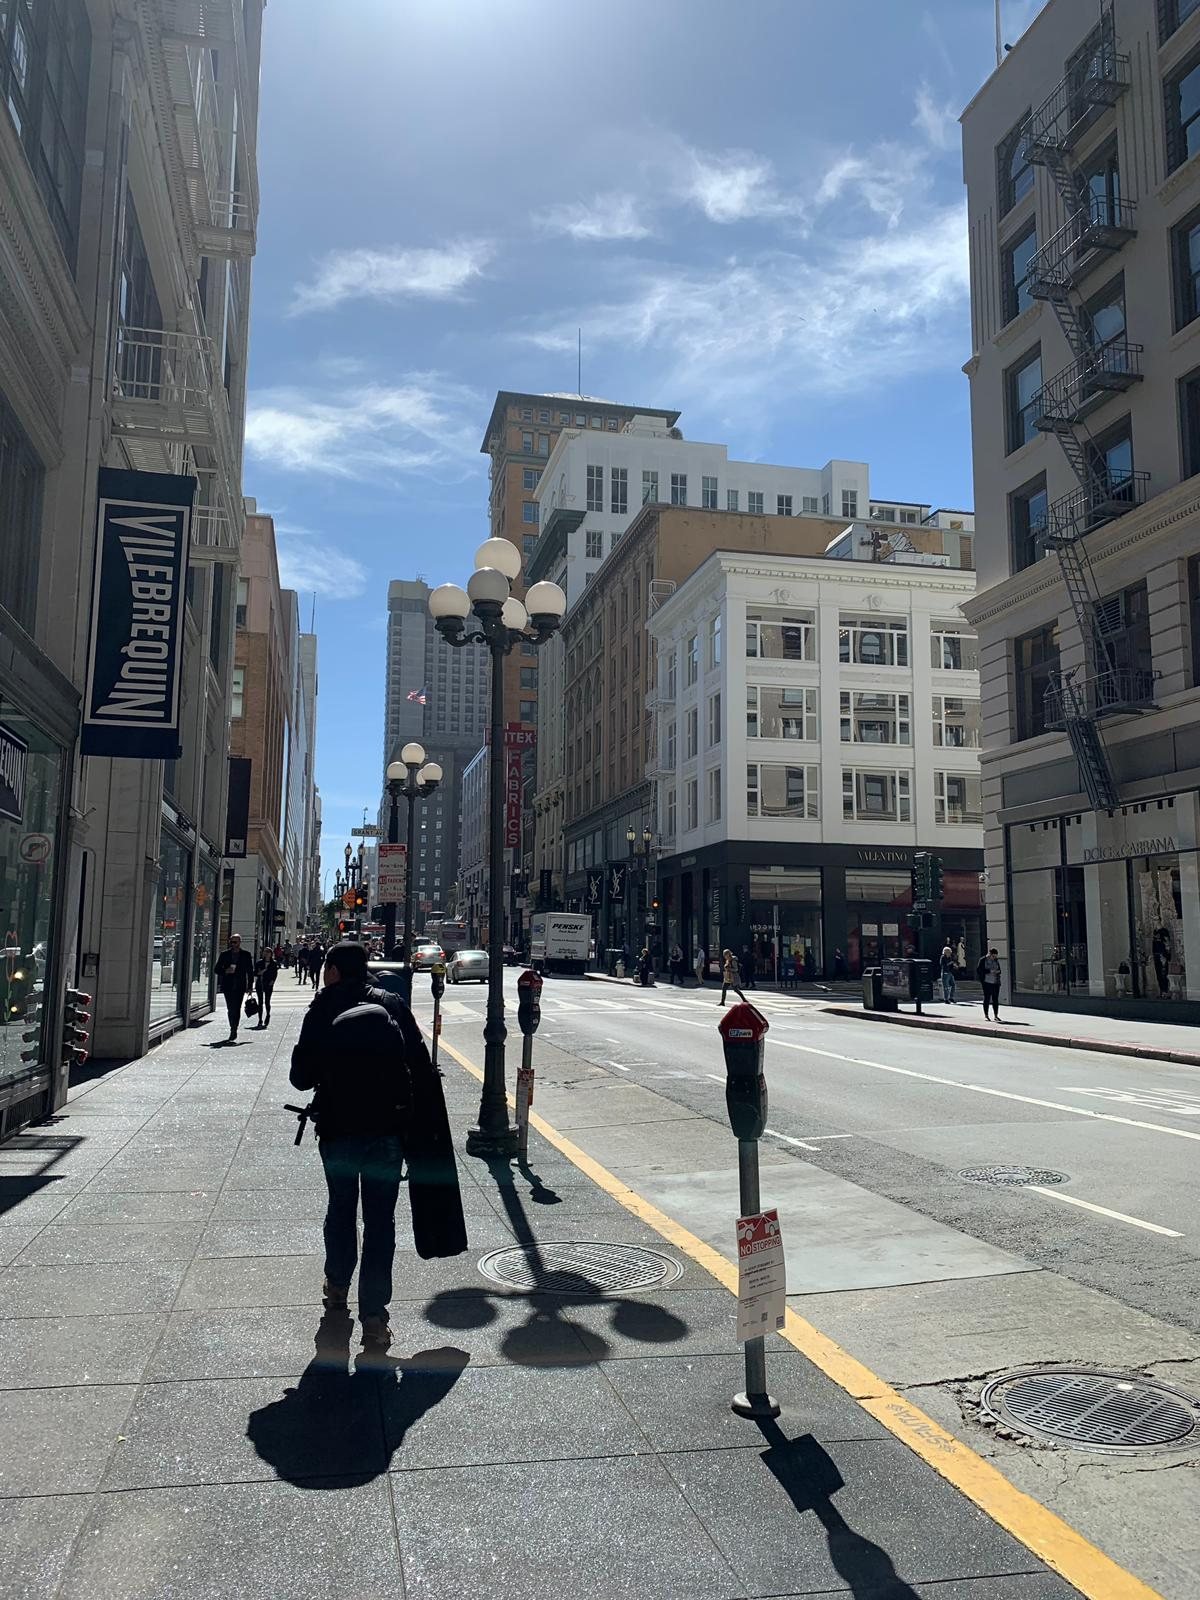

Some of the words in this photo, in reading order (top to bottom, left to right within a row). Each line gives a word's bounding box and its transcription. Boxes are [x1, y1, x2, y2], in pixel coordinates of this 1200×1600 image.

[96, 515, 177, 718] VILEBREQUIN
[0, 737, 25, 812] EQUIN
[508, 749, 519, 844] FABRICS
[857, 851, 908, 861] VALENTINO
[551, 923, 585, 931] PENSKE
[740, 1244, 753, 1257] NO
[752, 1236, 781, 1253] STOPPING
